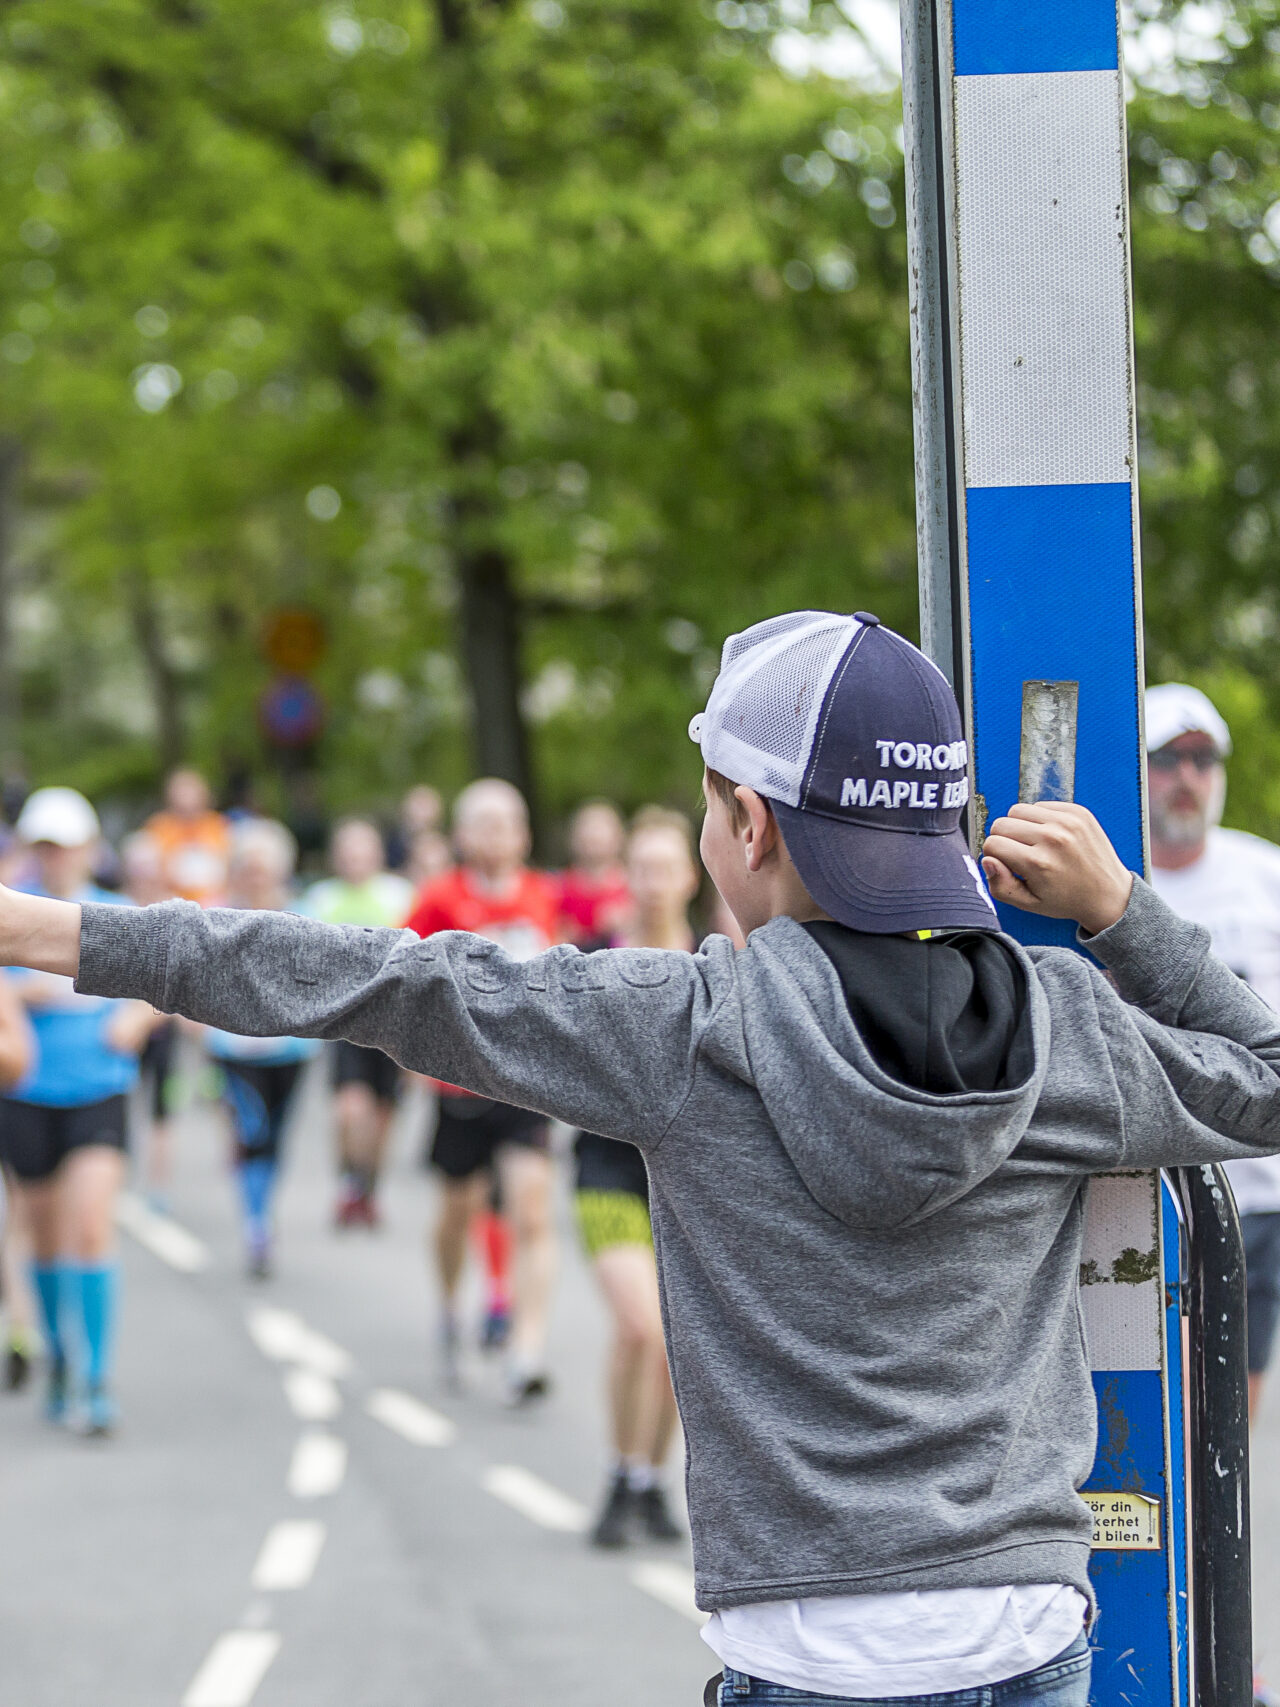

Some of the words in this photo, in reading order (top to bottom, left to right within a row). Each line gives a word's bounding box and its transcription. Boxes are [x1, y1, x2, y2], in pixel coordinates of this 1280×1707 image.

[840, 778, 939, 809] MAPLE
[1111, 1502, 1131, 1512] din
[1106, 1531, 1140, 1541] bilen
